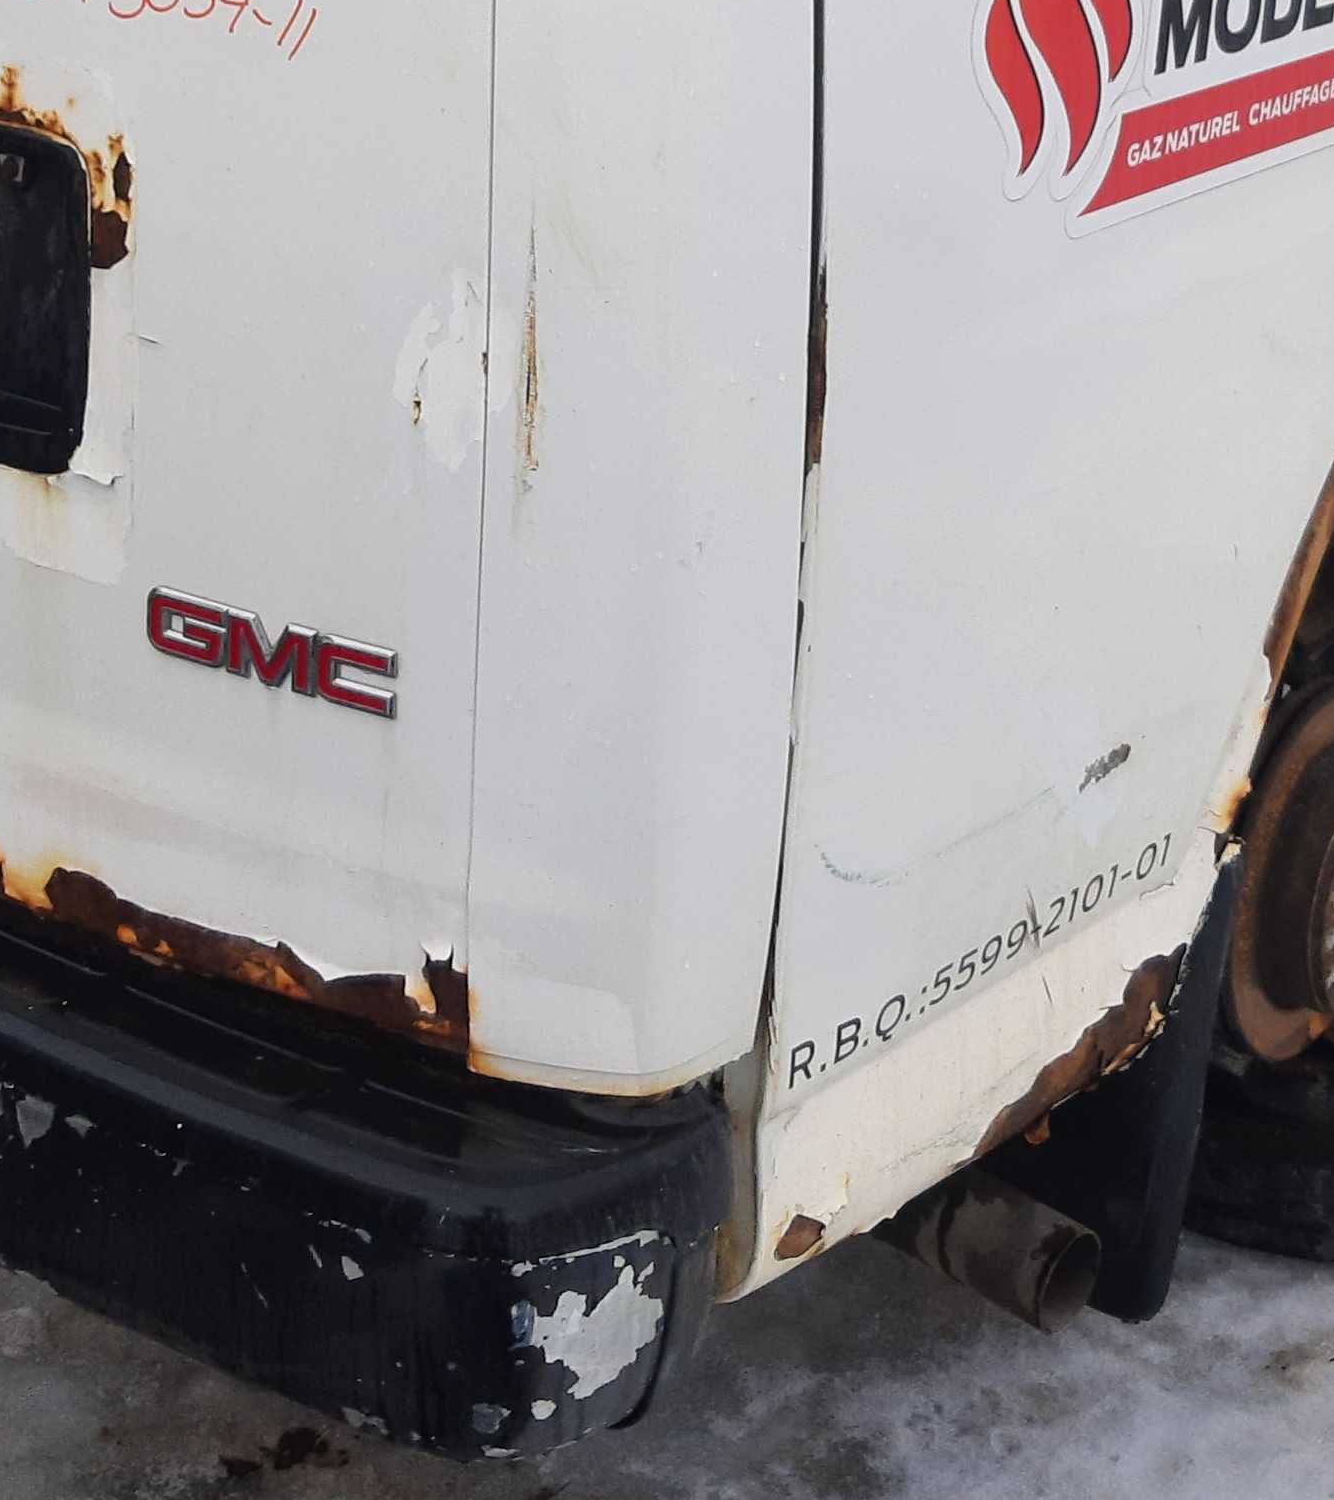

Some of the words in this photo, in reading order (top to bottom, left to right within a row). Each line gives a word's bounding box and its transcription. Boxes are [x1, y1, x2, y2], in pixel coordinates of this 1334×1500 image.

[1126, 132, 1165, 168] GAZ
[1165, 111, 1240, 155] NATUREL
[147, 585, 399, 721] GMC
